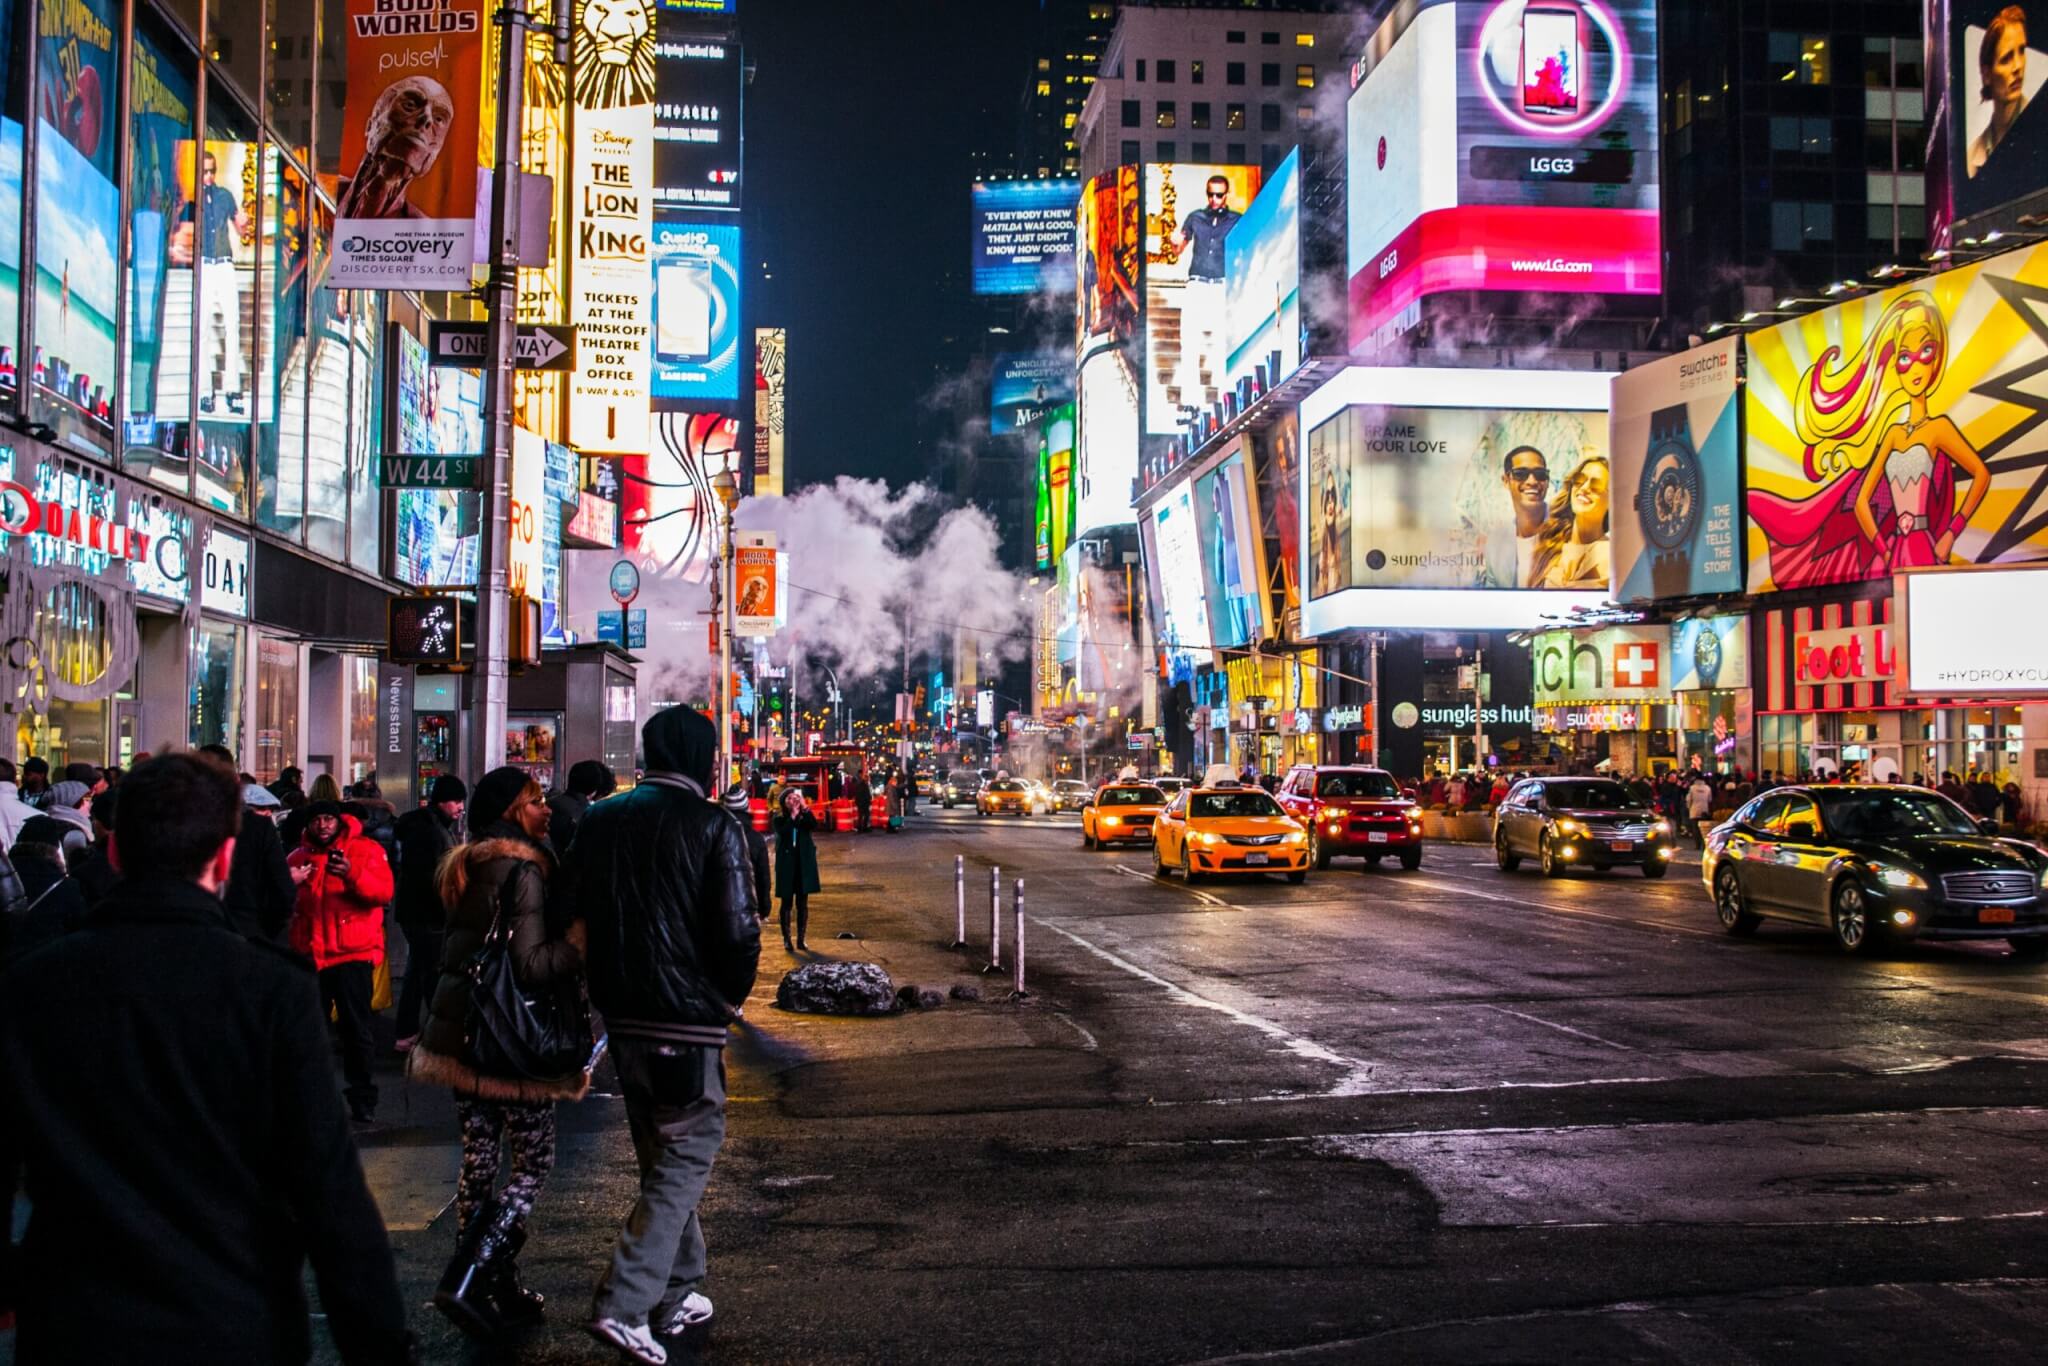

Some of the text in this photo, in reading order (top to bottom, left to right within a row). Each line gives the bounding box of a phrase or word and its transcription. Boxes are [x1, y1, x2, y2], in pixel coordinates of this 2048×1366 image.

[375, 0, 450, 13] BODY
[353, 11, 478, 37] WORLDS
[379, 44, 440, 73] pulse
[1356, 55, 1366, 81] LG
[588, 128, 633, 148] Disney
[591, 162, 630, 182] THE
[1530, 157, 1574, 173] LG G3
[1043, 209, 1072, 219] KNEW
[982, 220, 1075, 232] MATILDA WAS GOOD,
[660, 230, 709, 245] Quad HD
[987, 232, 1069, 244] THEY JUST DIDN'T
[986, 245, 1017, 255] KNOW
[1017, 244, 1041, 254] HOW
[340, 264, 466, 275] DISCOVERYTSX.COM
[1379, 250, 1398, 279] LG G3
[1511, 258, 1593, 273] www.LG.com
[584, 292, 638, 305] TICKETS
[588, 308, 635, 320] AT THE
[575, 322, 648, 336] MINSKOFF
[451, 336, 554, 357] ONE WAY
[581, 338, 640, 351] THEATRE
[595, 354, 625, 365] BOX
[1680, 353, 1720, 378] swatch
[587, 369, 634, 381] OFFICE
[612, 388, 619, 396] &
[1364, 426, 1417, 438] FRAME
[1364, 440, 1448, 453] YOUR LOVE
[386, 458, 468, 485] W 44 St
[1712, 504, 1730, 517] THE
[47, 501, 151, 562] OAKLEY
[1707, 518, 1730, 532] BACK
[1705, 532, 1731, 546] TELLS
[1714, 546, 1732, 559] THE
[1391, 551, 1484, 569] sunglass hut
[1704, 560, 1732, 574] STORY
[1796, 634, 1866, 681] Foot
[389, 676, 402, 752] Newsstand
[1421, 703, 1532, 728] sunglass hut
[1567, 709, 1622, 727] swatch
